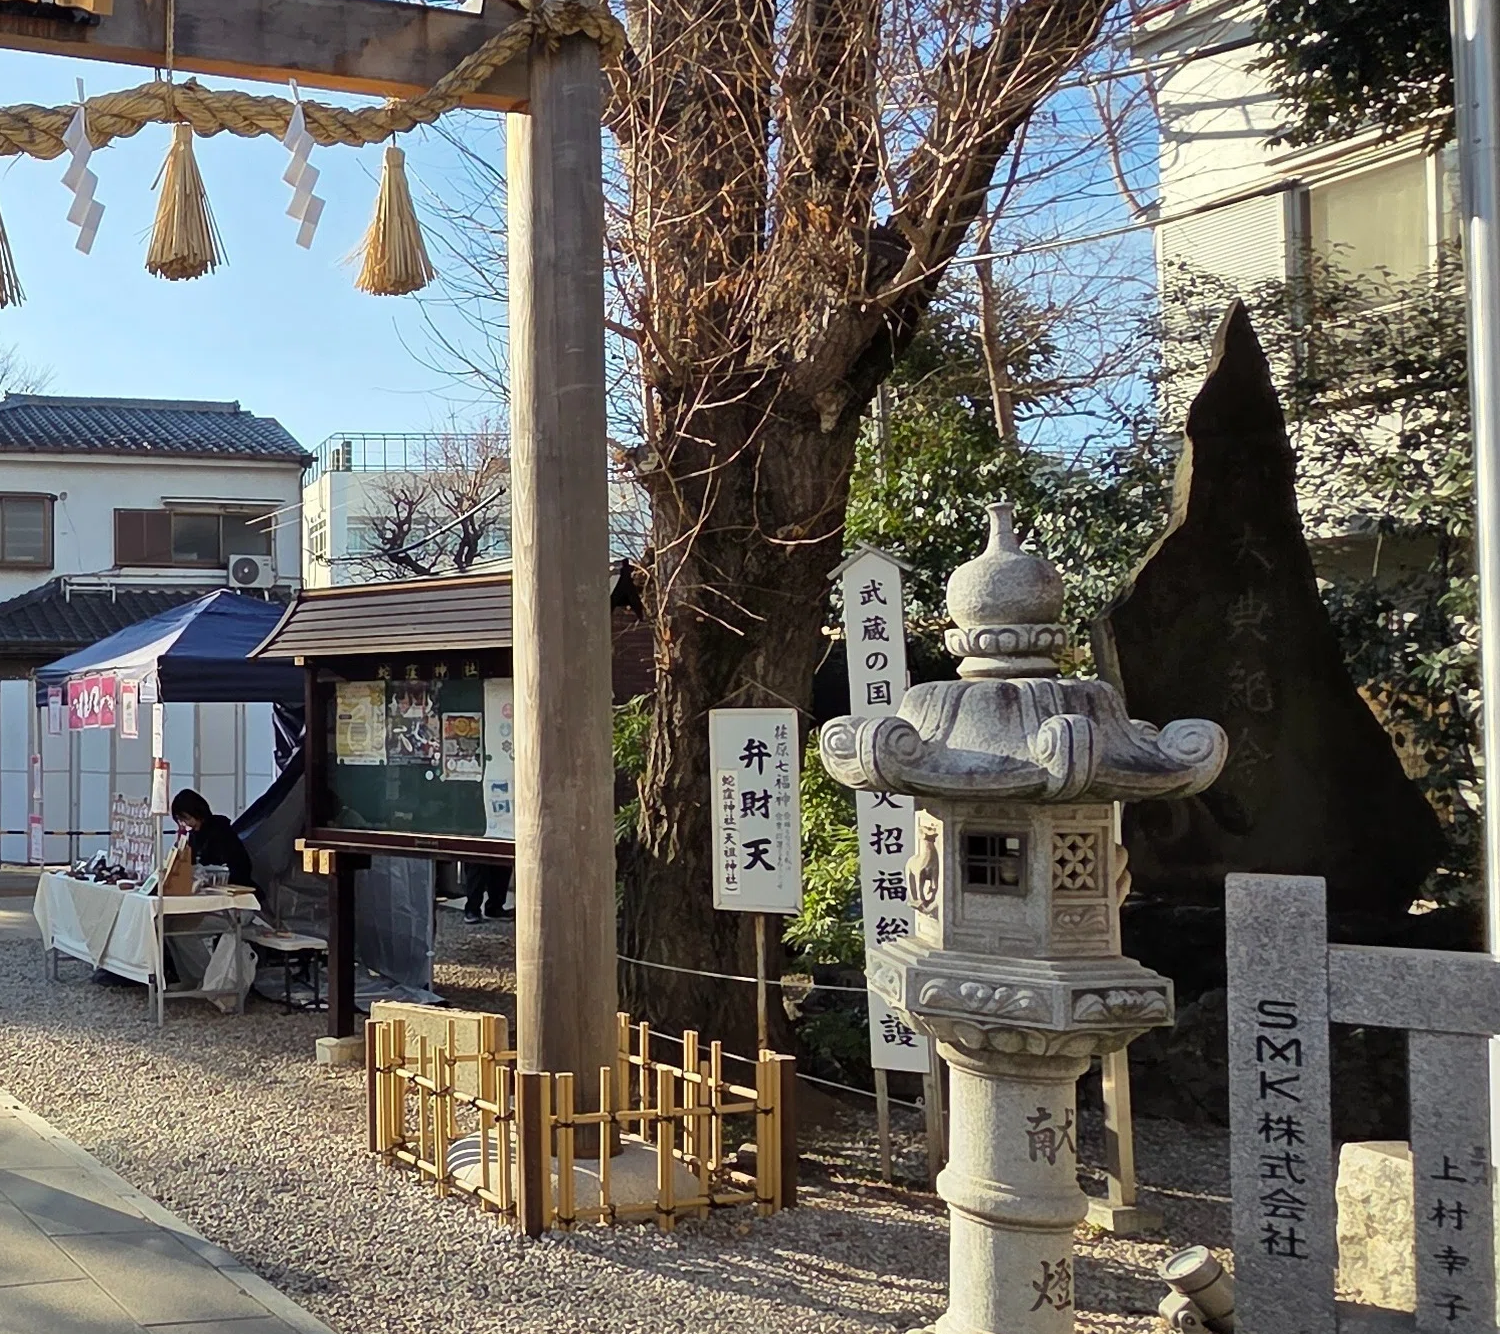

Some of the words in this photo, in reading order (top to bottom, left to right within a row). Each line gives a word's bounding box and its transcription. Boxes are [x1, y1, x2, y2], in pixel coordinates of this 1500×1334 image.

[738, 738, 776, 871] 弁財天
[1257, 1000, 1309, 1259] SMK株式会社
[1427, 1155, 1472, 1321] 上村幸子
